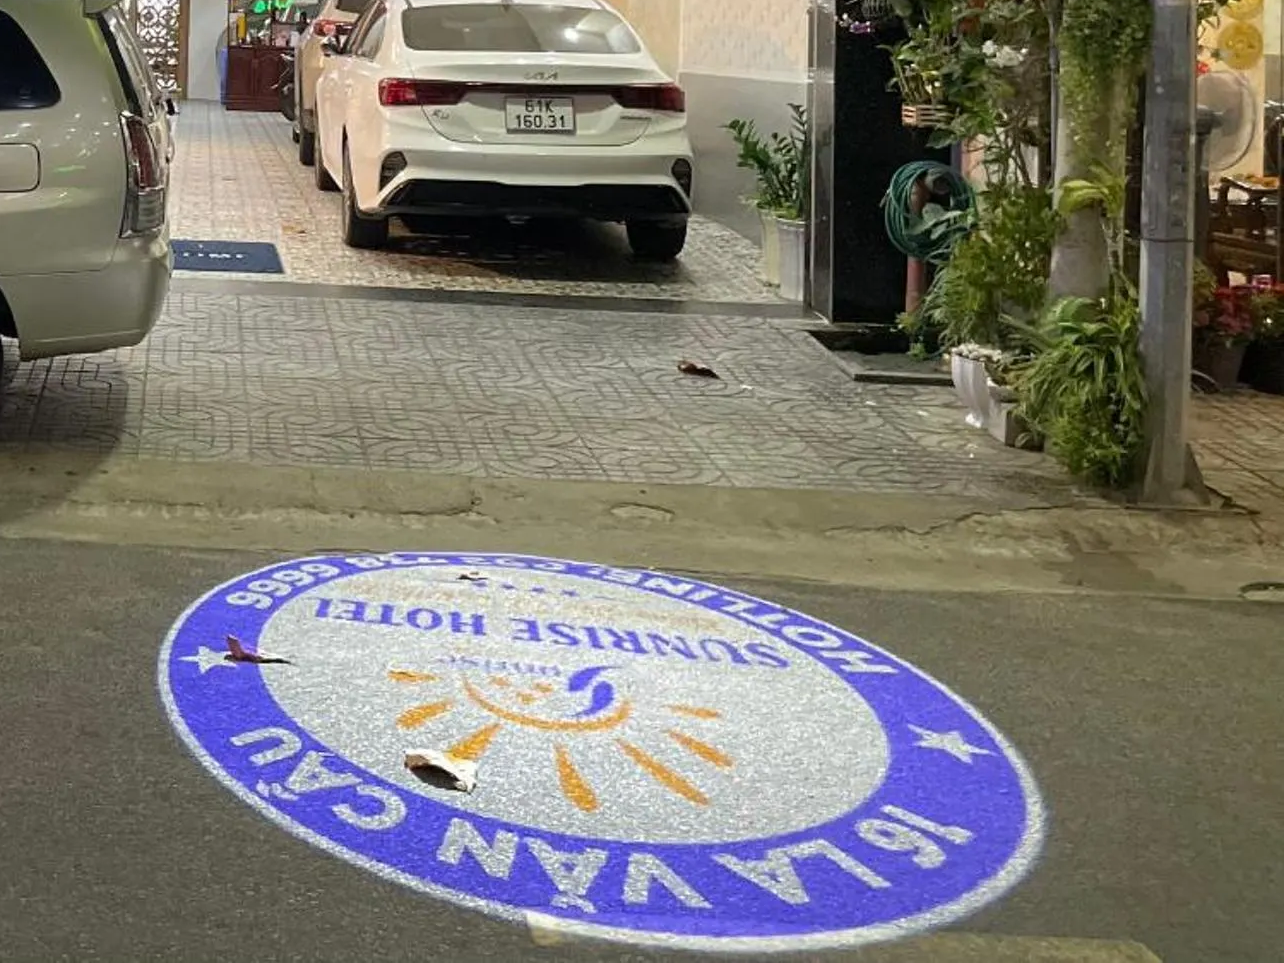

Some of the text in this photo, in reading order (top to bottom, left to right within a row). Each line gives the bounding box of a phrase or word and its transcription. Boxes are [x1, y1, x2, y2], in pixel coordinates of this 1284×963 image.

[515, 114, 566, 129] 160.31
[227, 562, 341, 611] 6666
[510, 617, 790, 669] SUNRISE
[436, 817, 713, 914] VĂN
[854, 804, 973, 870] 16
[712, 838, 892, 906] LA
